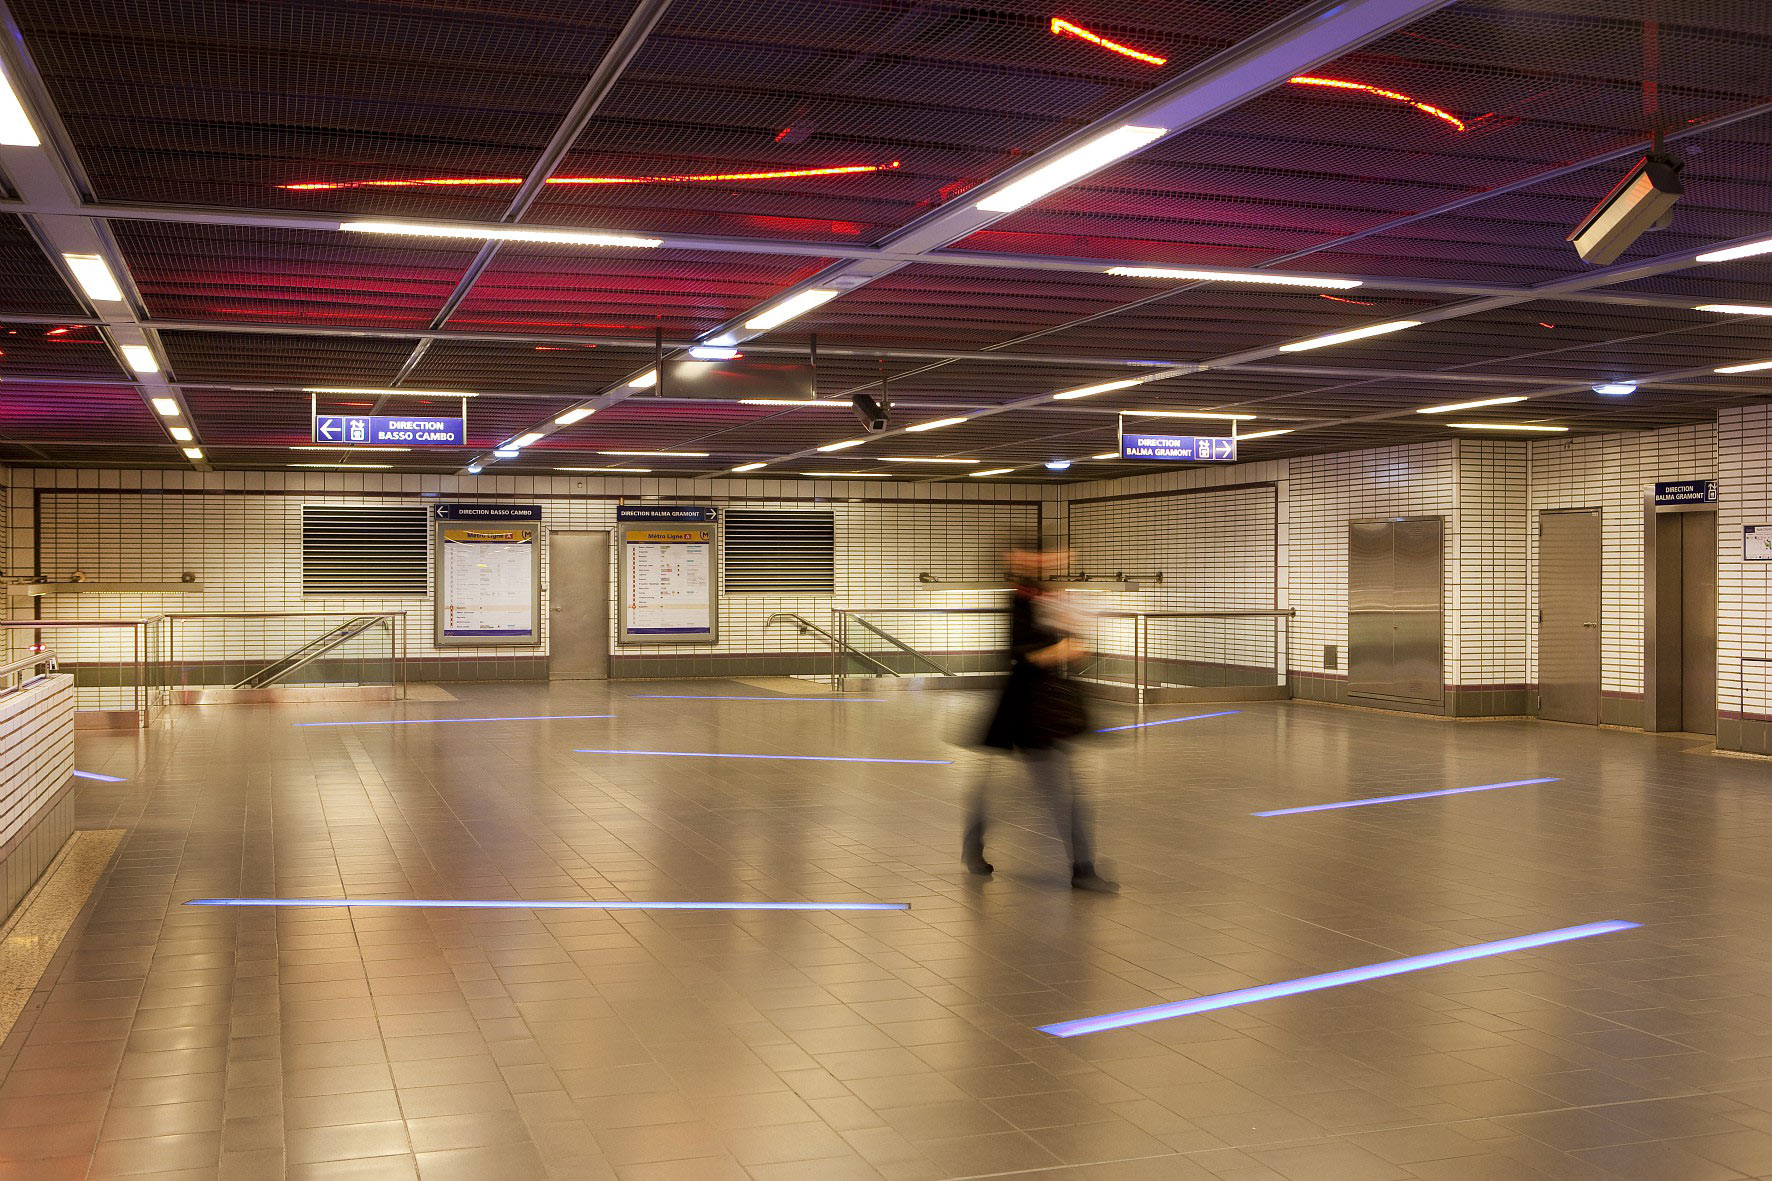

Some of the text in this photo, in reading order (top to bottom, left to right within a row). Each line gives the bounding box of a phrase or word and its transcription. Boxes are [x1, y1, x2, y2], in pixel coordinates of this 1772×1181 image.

[389, 421, 444, 430] DIRECTION
[378, 431, 455, 441] BASSO CAMBO
[1137, 438, 1181, 447] DIRECTION
[1126, 447, 1192, 457] BALMA GRAMONT
[1665, 485, 1694, 493] DIRECTION
[1675, 492, 1704, 500] GRAMONT
